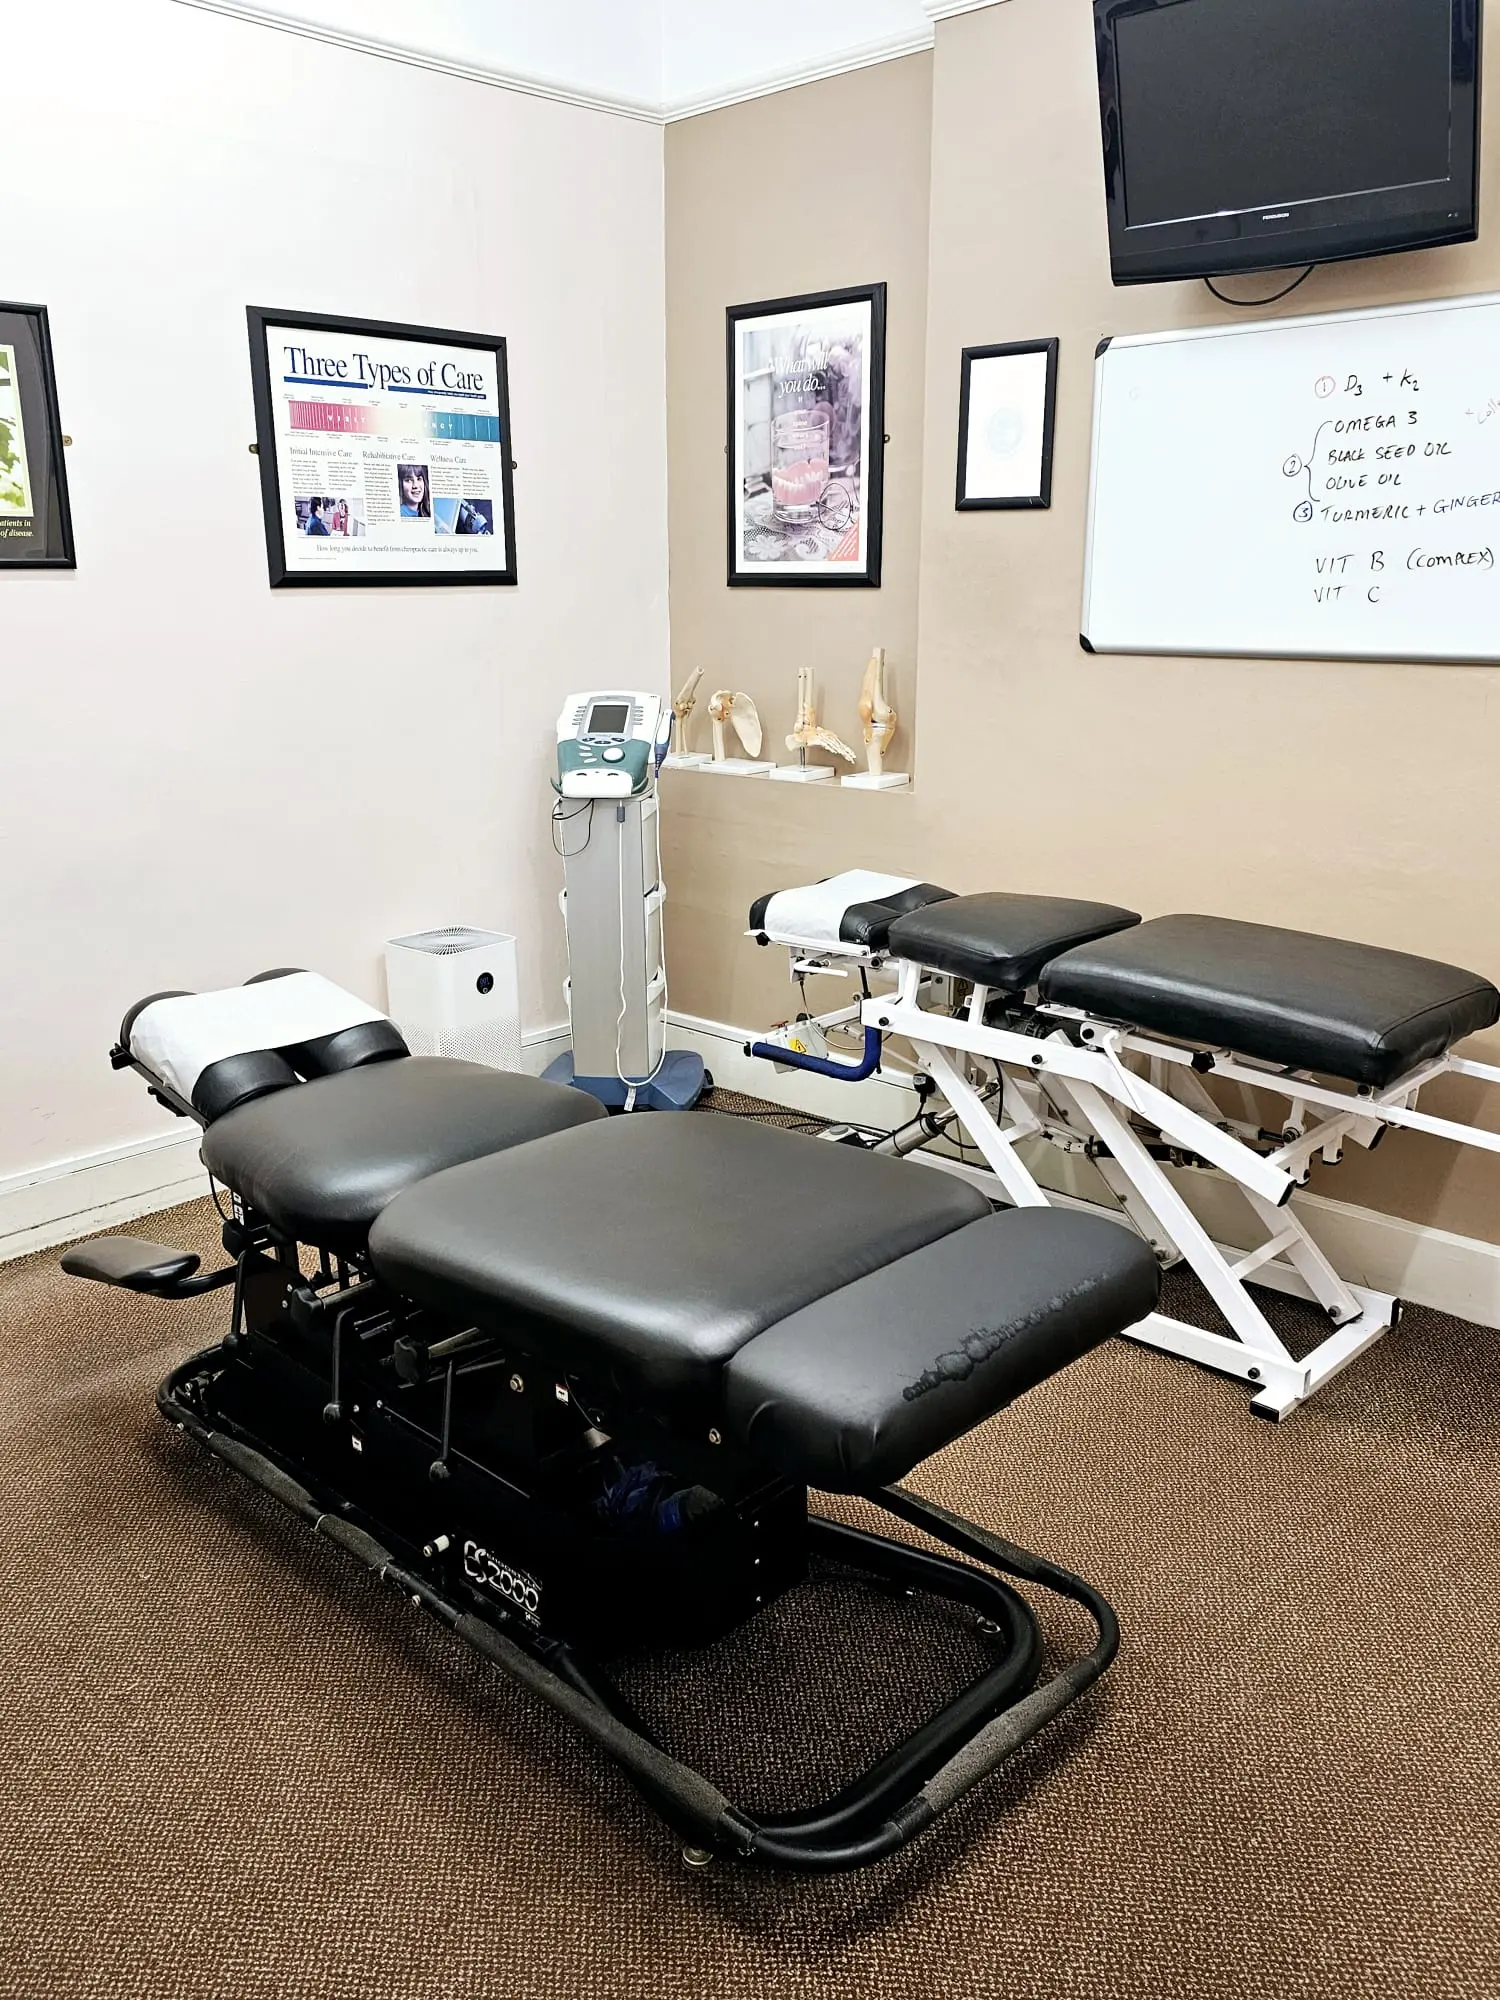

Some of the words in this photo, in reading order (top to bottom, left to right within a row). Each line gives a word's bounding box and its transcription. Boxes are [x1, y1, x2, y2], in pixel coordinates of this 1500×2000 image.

[284, 346, 348, 378] Three
[353, 353, 411, 389] Types
[417, 361, 437, 387] of
[441, 363, 484, 391] Care
[774, 354, 805, 375] What
[806, 351, 828, 371] will
[778, 379, 801, 398] you
[1334, 415, 1396, 434] OMEGA
[1407, 411, 1418, 425] 3
[1328, 449, 1365, 465] BLACK
[1375, 444, 1416, 460] SEED
[1424, 442, 1452, 456] OIL
[1326, 474, 1368, 490] OLIVE
[1378, 473, 1402, 486] OIL
[1320, 505, 1409, 522] TURMERIC
[1433, 491, 1500, 514] GINGER
[1316, 554, 1355, 574] VIT
[1371, 550, 1385, 572] B
[1313, 585, 1346, 603] VIT
[1367, 586, 1380, 603] C
